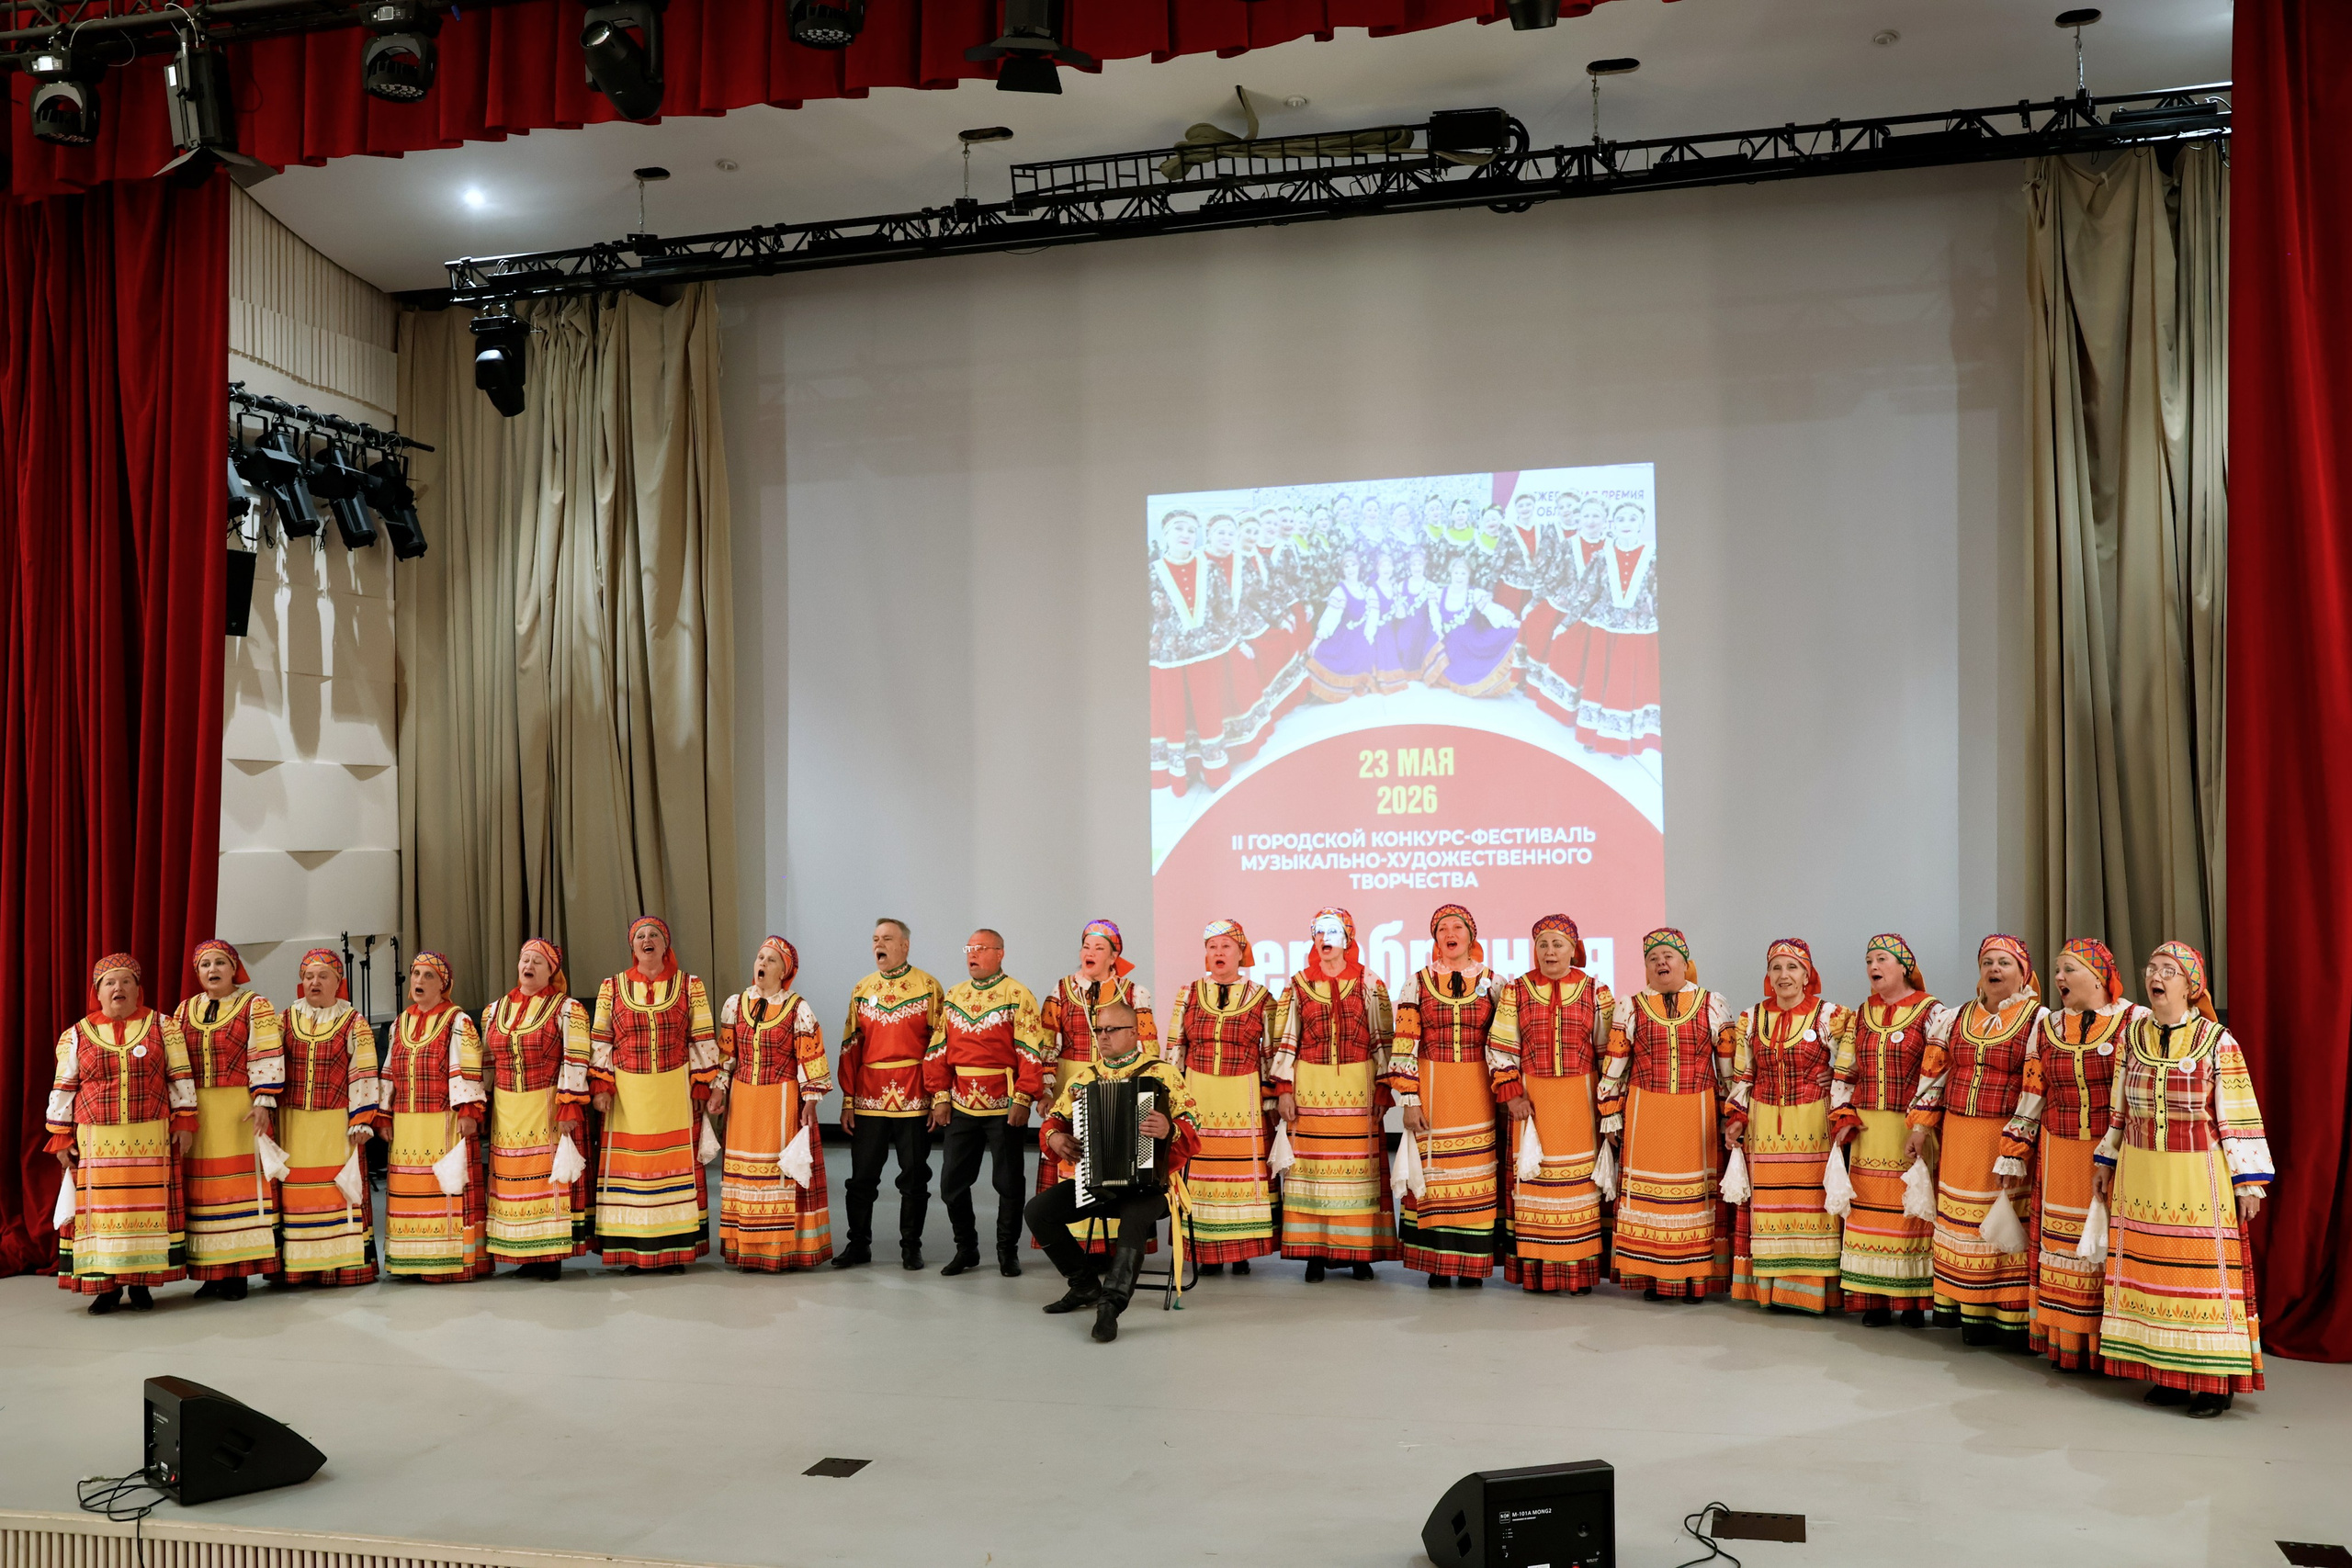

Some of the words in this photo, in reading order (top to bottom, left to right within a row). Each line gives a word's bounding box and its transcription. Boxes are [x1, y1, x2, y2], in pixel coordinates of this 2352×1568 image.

[1359, 749, 1389, 779] 23
[1397, 747, 1454, 777] МАЯ
[1376, 784, 1438, 815] 2026
[1231, 834, 1244, 851] II
[1248, 828, 1366, 852] ГОРОДСКОЙ
[1371, 826, 1597, 848] КОНКУРС-ФЕСТИВАЛЬ
[1240, 847, 1593, 872] МУЗЫКАЛЬНО-ХУДОЖЕСТВЕННОГО
[1349, 871, 1479, 890] ТВОРЧЕСТВА
